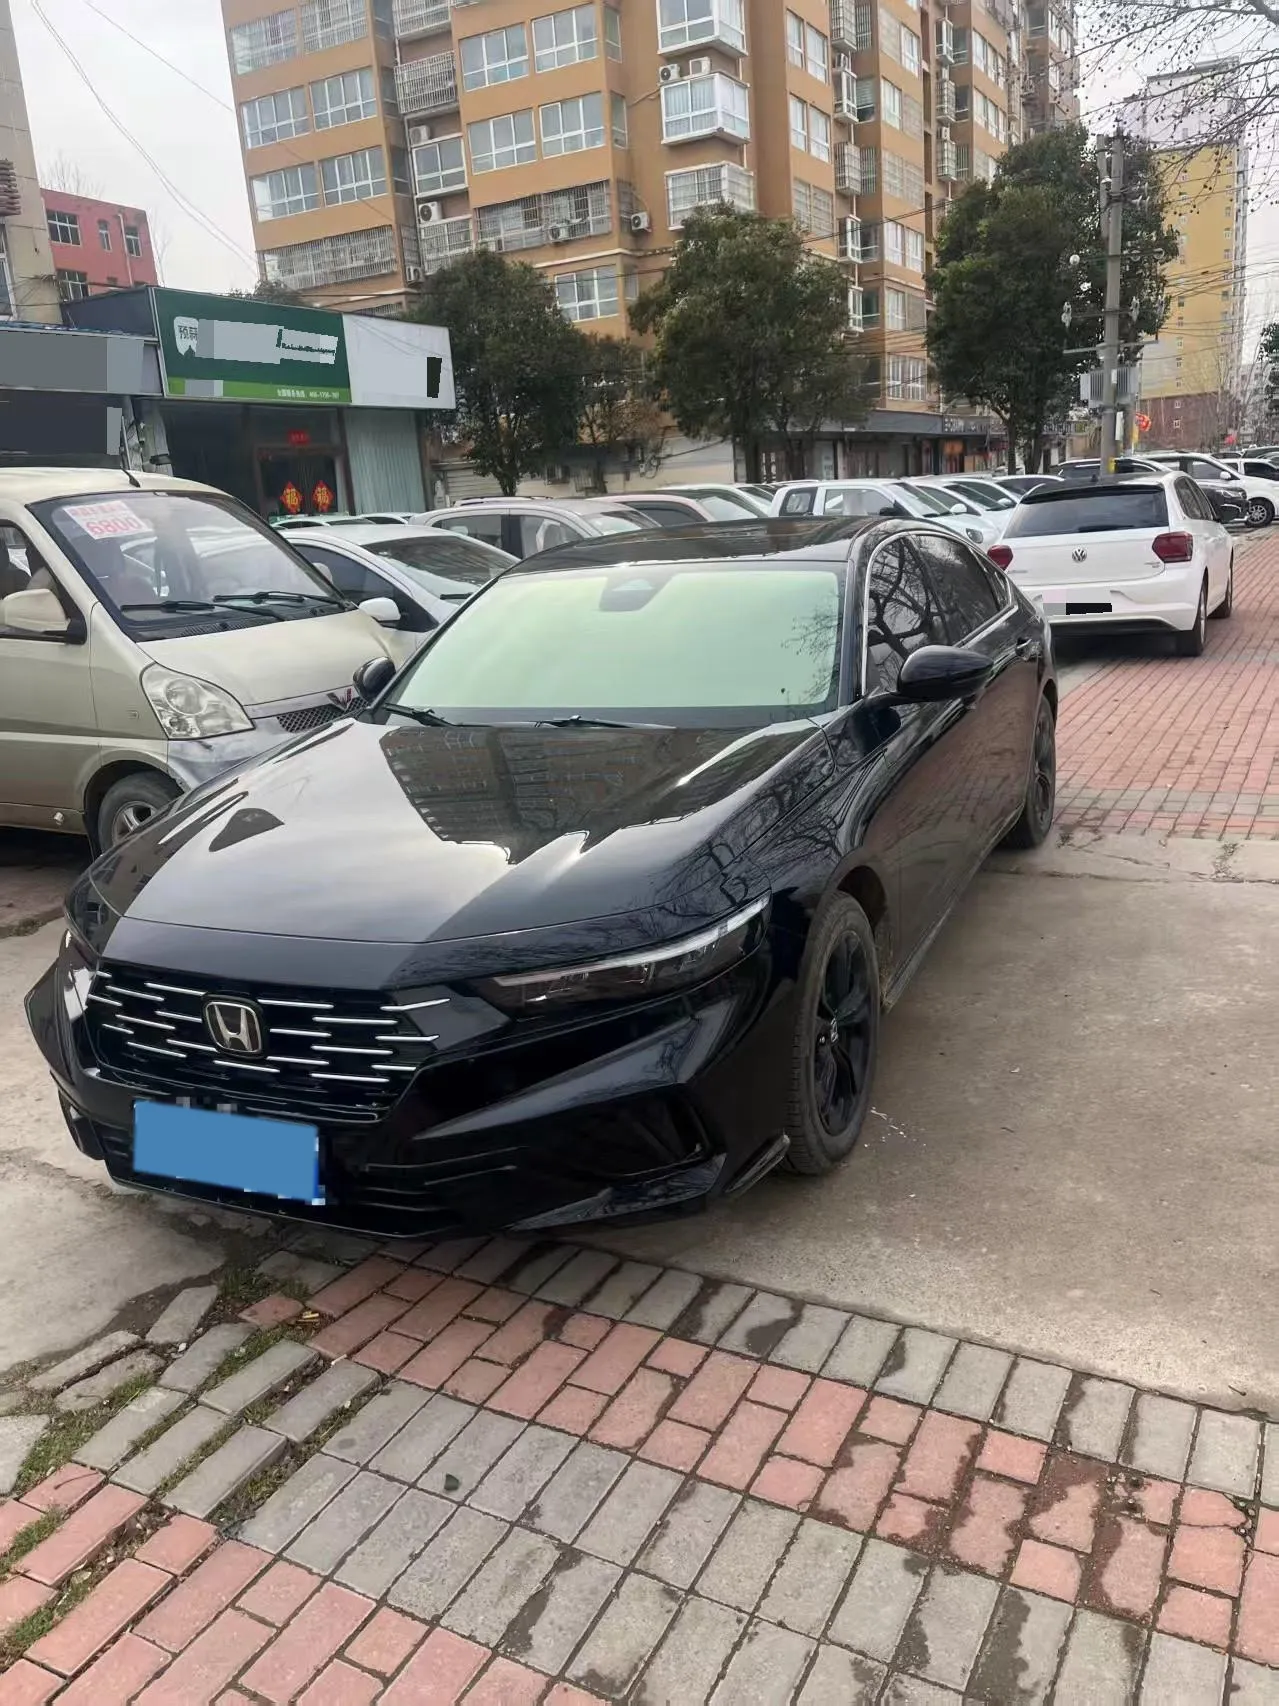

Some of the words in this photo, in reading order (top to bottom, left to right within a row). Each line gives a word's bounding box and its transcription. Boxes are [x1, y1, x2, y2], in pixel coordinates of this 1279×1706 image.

[286, 488, 299, 505] 福
[317, 486, 329, 505] 福
[86, 517, 141, 535] 6800
